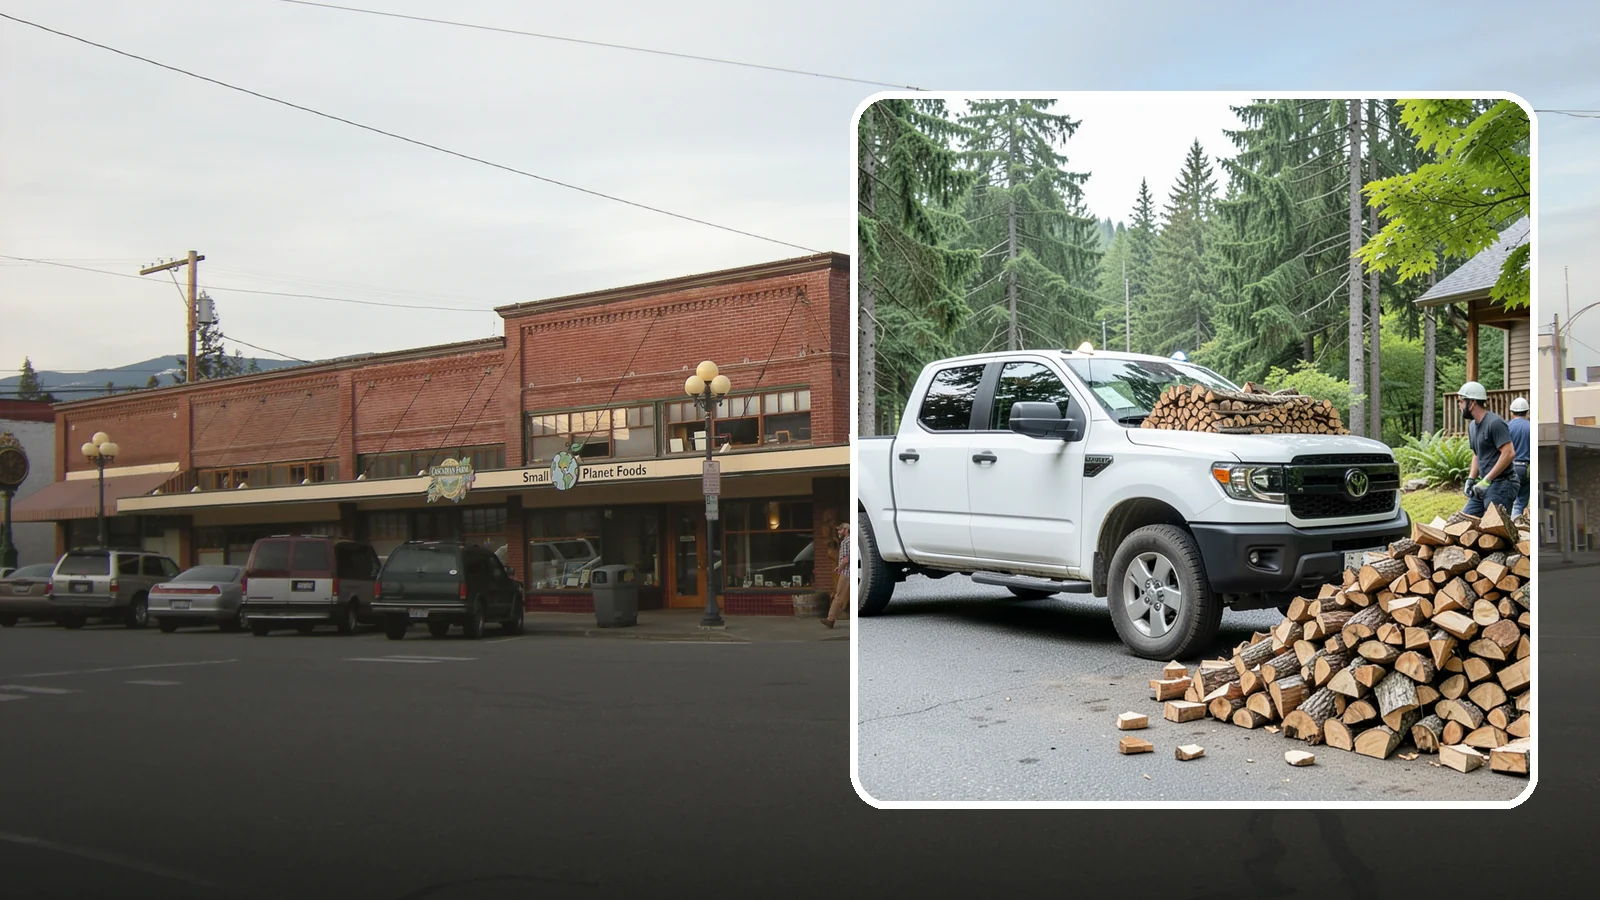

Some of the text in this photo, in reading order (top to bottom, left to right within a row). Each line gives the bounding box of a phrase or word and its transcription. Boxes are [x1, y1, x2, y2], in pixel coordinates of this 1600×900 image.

[523, 464, 647, 483] Small Planet Foods
